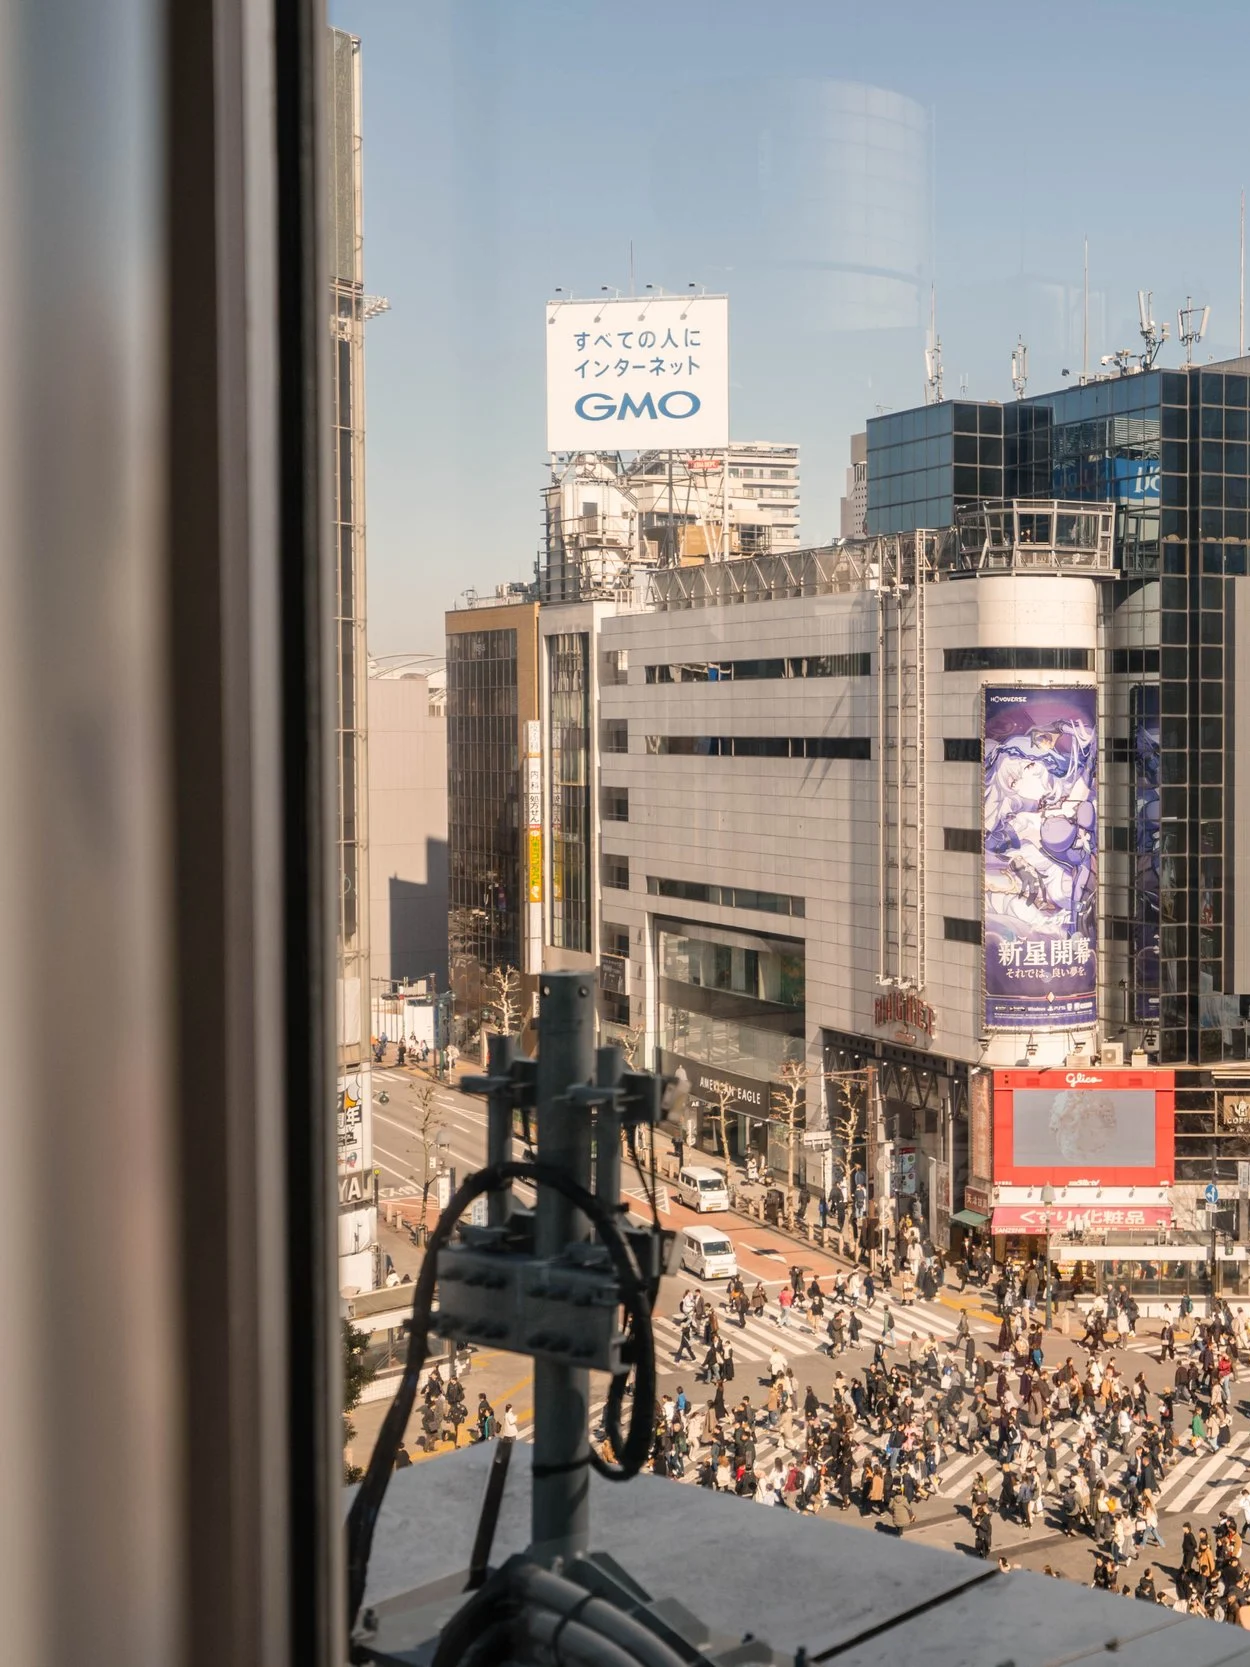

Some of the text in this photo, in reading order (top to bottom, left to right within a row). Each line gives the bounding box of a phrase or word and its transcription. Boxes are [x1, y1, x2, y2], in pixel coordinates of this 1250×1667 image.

[574, 328, 701, 351] すべての人に
[574, 355, 700, 378] インターネット
[574, 391, 701, 421] GMO
[529, 795, 540, 823] 処方せん
[998, 938, 1091, 966] 新星開幕
[1006, 966, 1087, 979] それでは、良い夢を。
[1065, 1072, 1103, 1087] Glico
[737, 1087, 761, 1105] EAGLE
